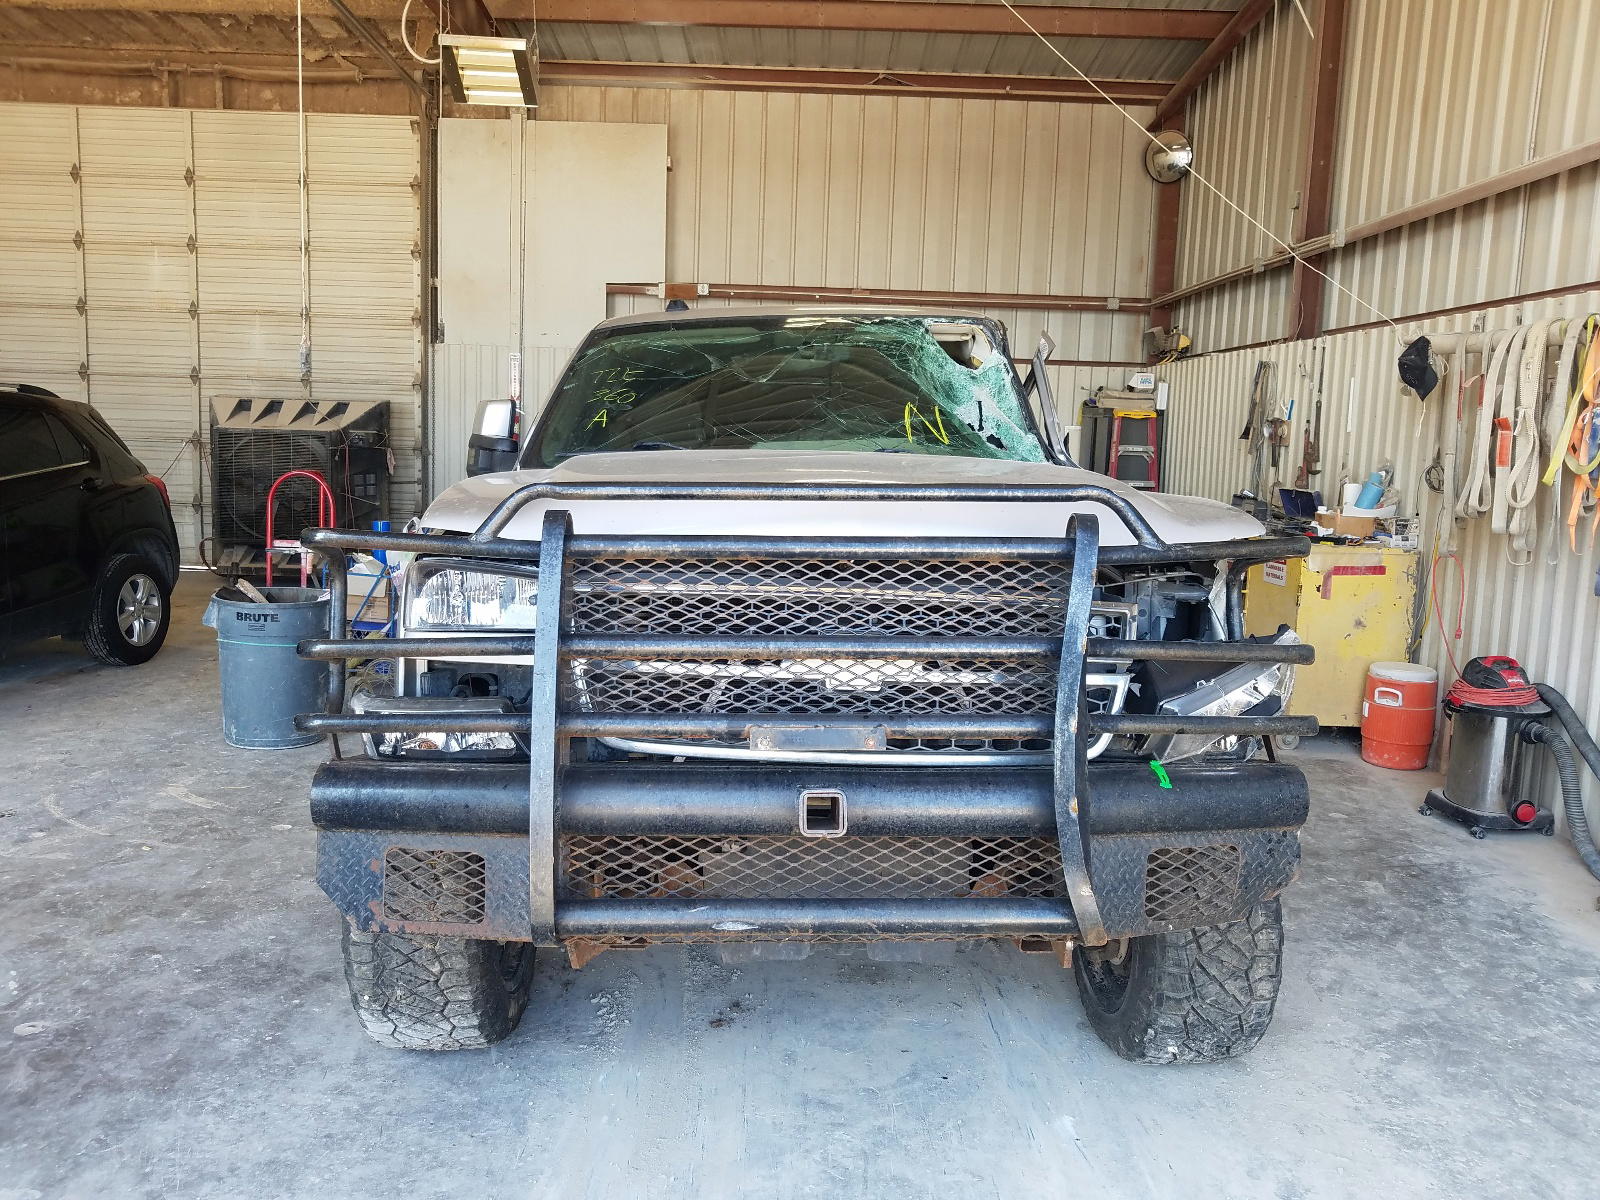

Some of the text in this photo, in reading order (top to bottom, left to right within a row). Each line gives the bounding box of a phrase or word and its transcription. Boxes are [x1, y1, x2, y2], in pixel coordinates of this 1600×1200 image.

[584, 409, 607, 431] A
[904, 401, 950, 445] N
[236, 612, 280, 623] BRUTE
